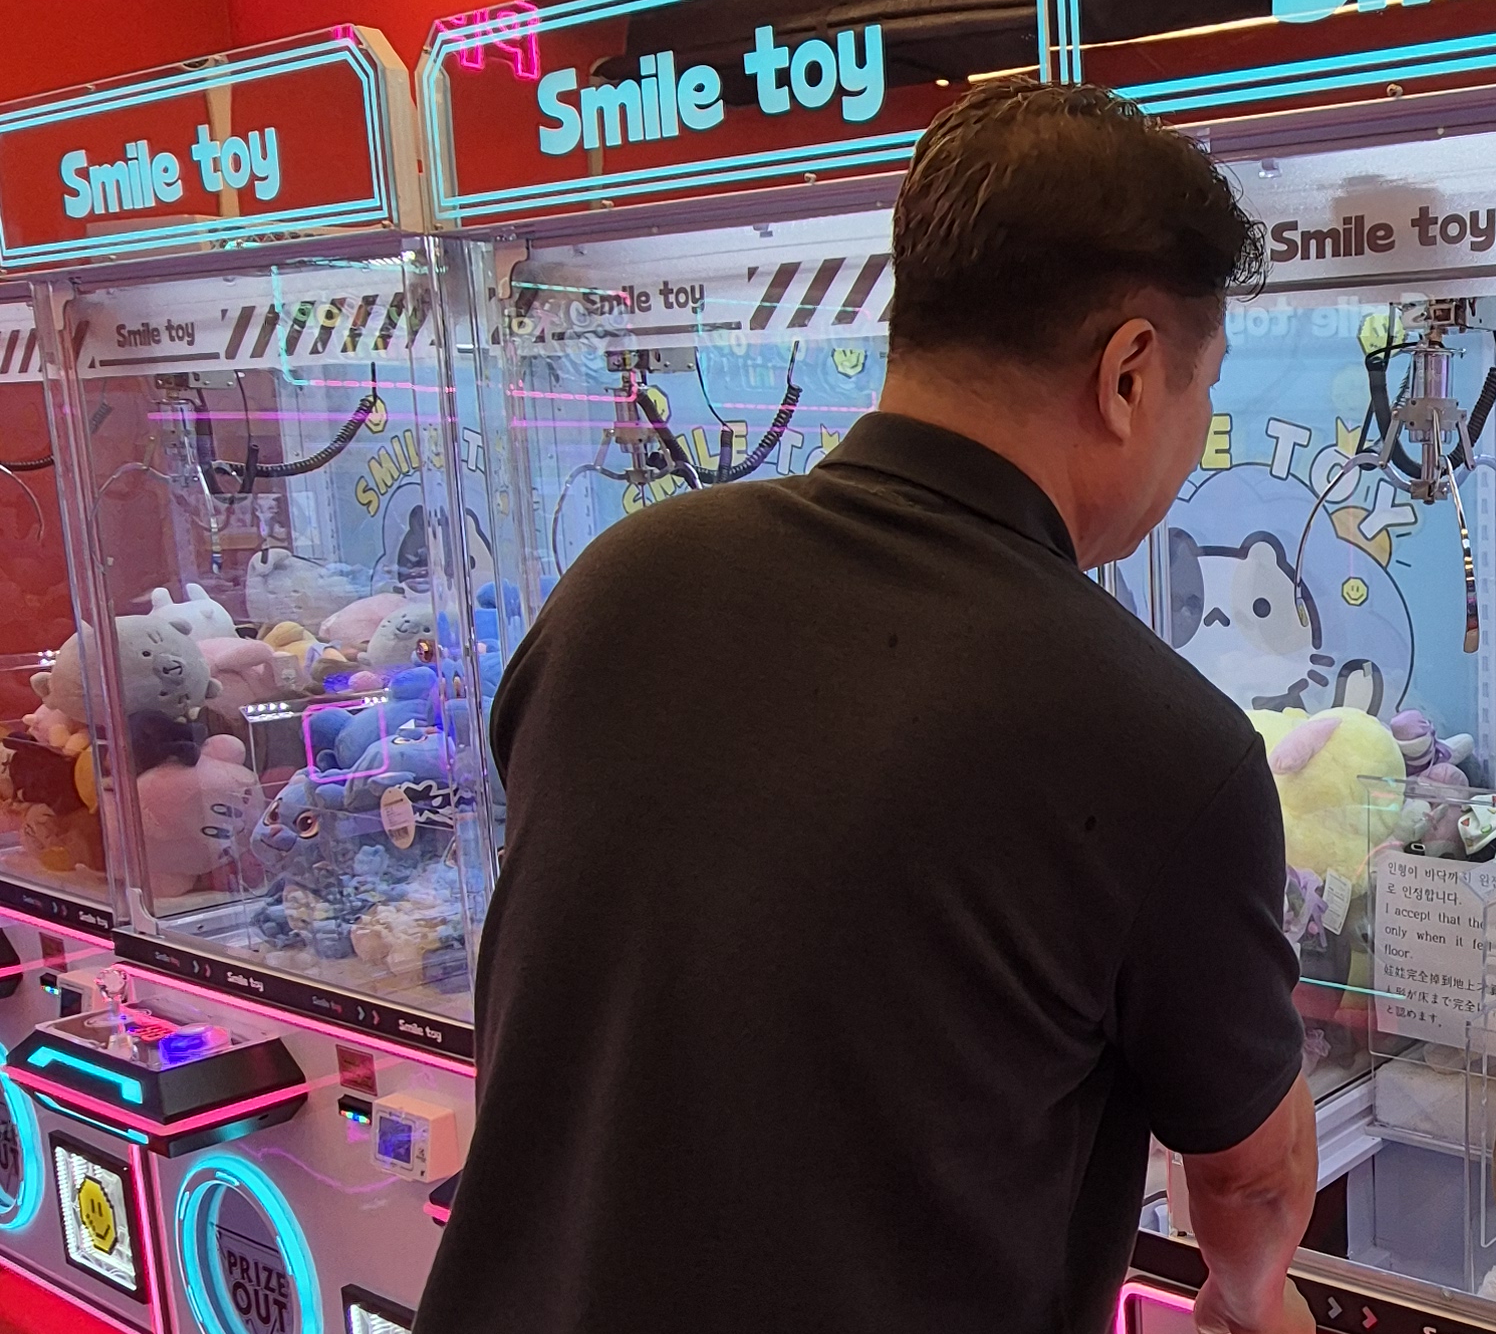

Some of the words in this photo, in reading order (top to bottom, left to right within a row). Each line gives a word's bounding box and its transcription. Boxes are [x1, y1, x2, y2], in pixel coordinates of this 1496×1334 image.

[538, 50, 724, 155] Smile
[743, 24, 885, 122] toy
[60, 139, 183, 218] Smile
[191, 124, 281, 200] toy
[1270, 214, 1395, 262] Smile
[1411, 206, 1496, 252] toy
[582, 285, 652, 315] Smile
[659, 281, 705, 313] toy
[115, 321, 160, 348] Smile
[165, 318, 195, 346] toy
[1265, 417, 1419, 540] TOY
[1388, 862, 1417, 879] 인형이
[1387, 883, 1396, 894] 로
[1402, 886, 1462, 906] 인정합니다.
[1395, 907, 1430, 922] accept
[1438, 912, 1460, 925] that
[1384, 944, 1413, 959] floor.
[1385, 926, 1407, 939] only
[1417, 930, 1446, 944] when
[1472, 938, 1491, 951] fel
[398, 1019, 424, 1036] Smile
[425, 1026, 442, 1043] toy
[227, 1250, 288, 1299] PRIZE
[232, 1281, 288, 1334] OUT
